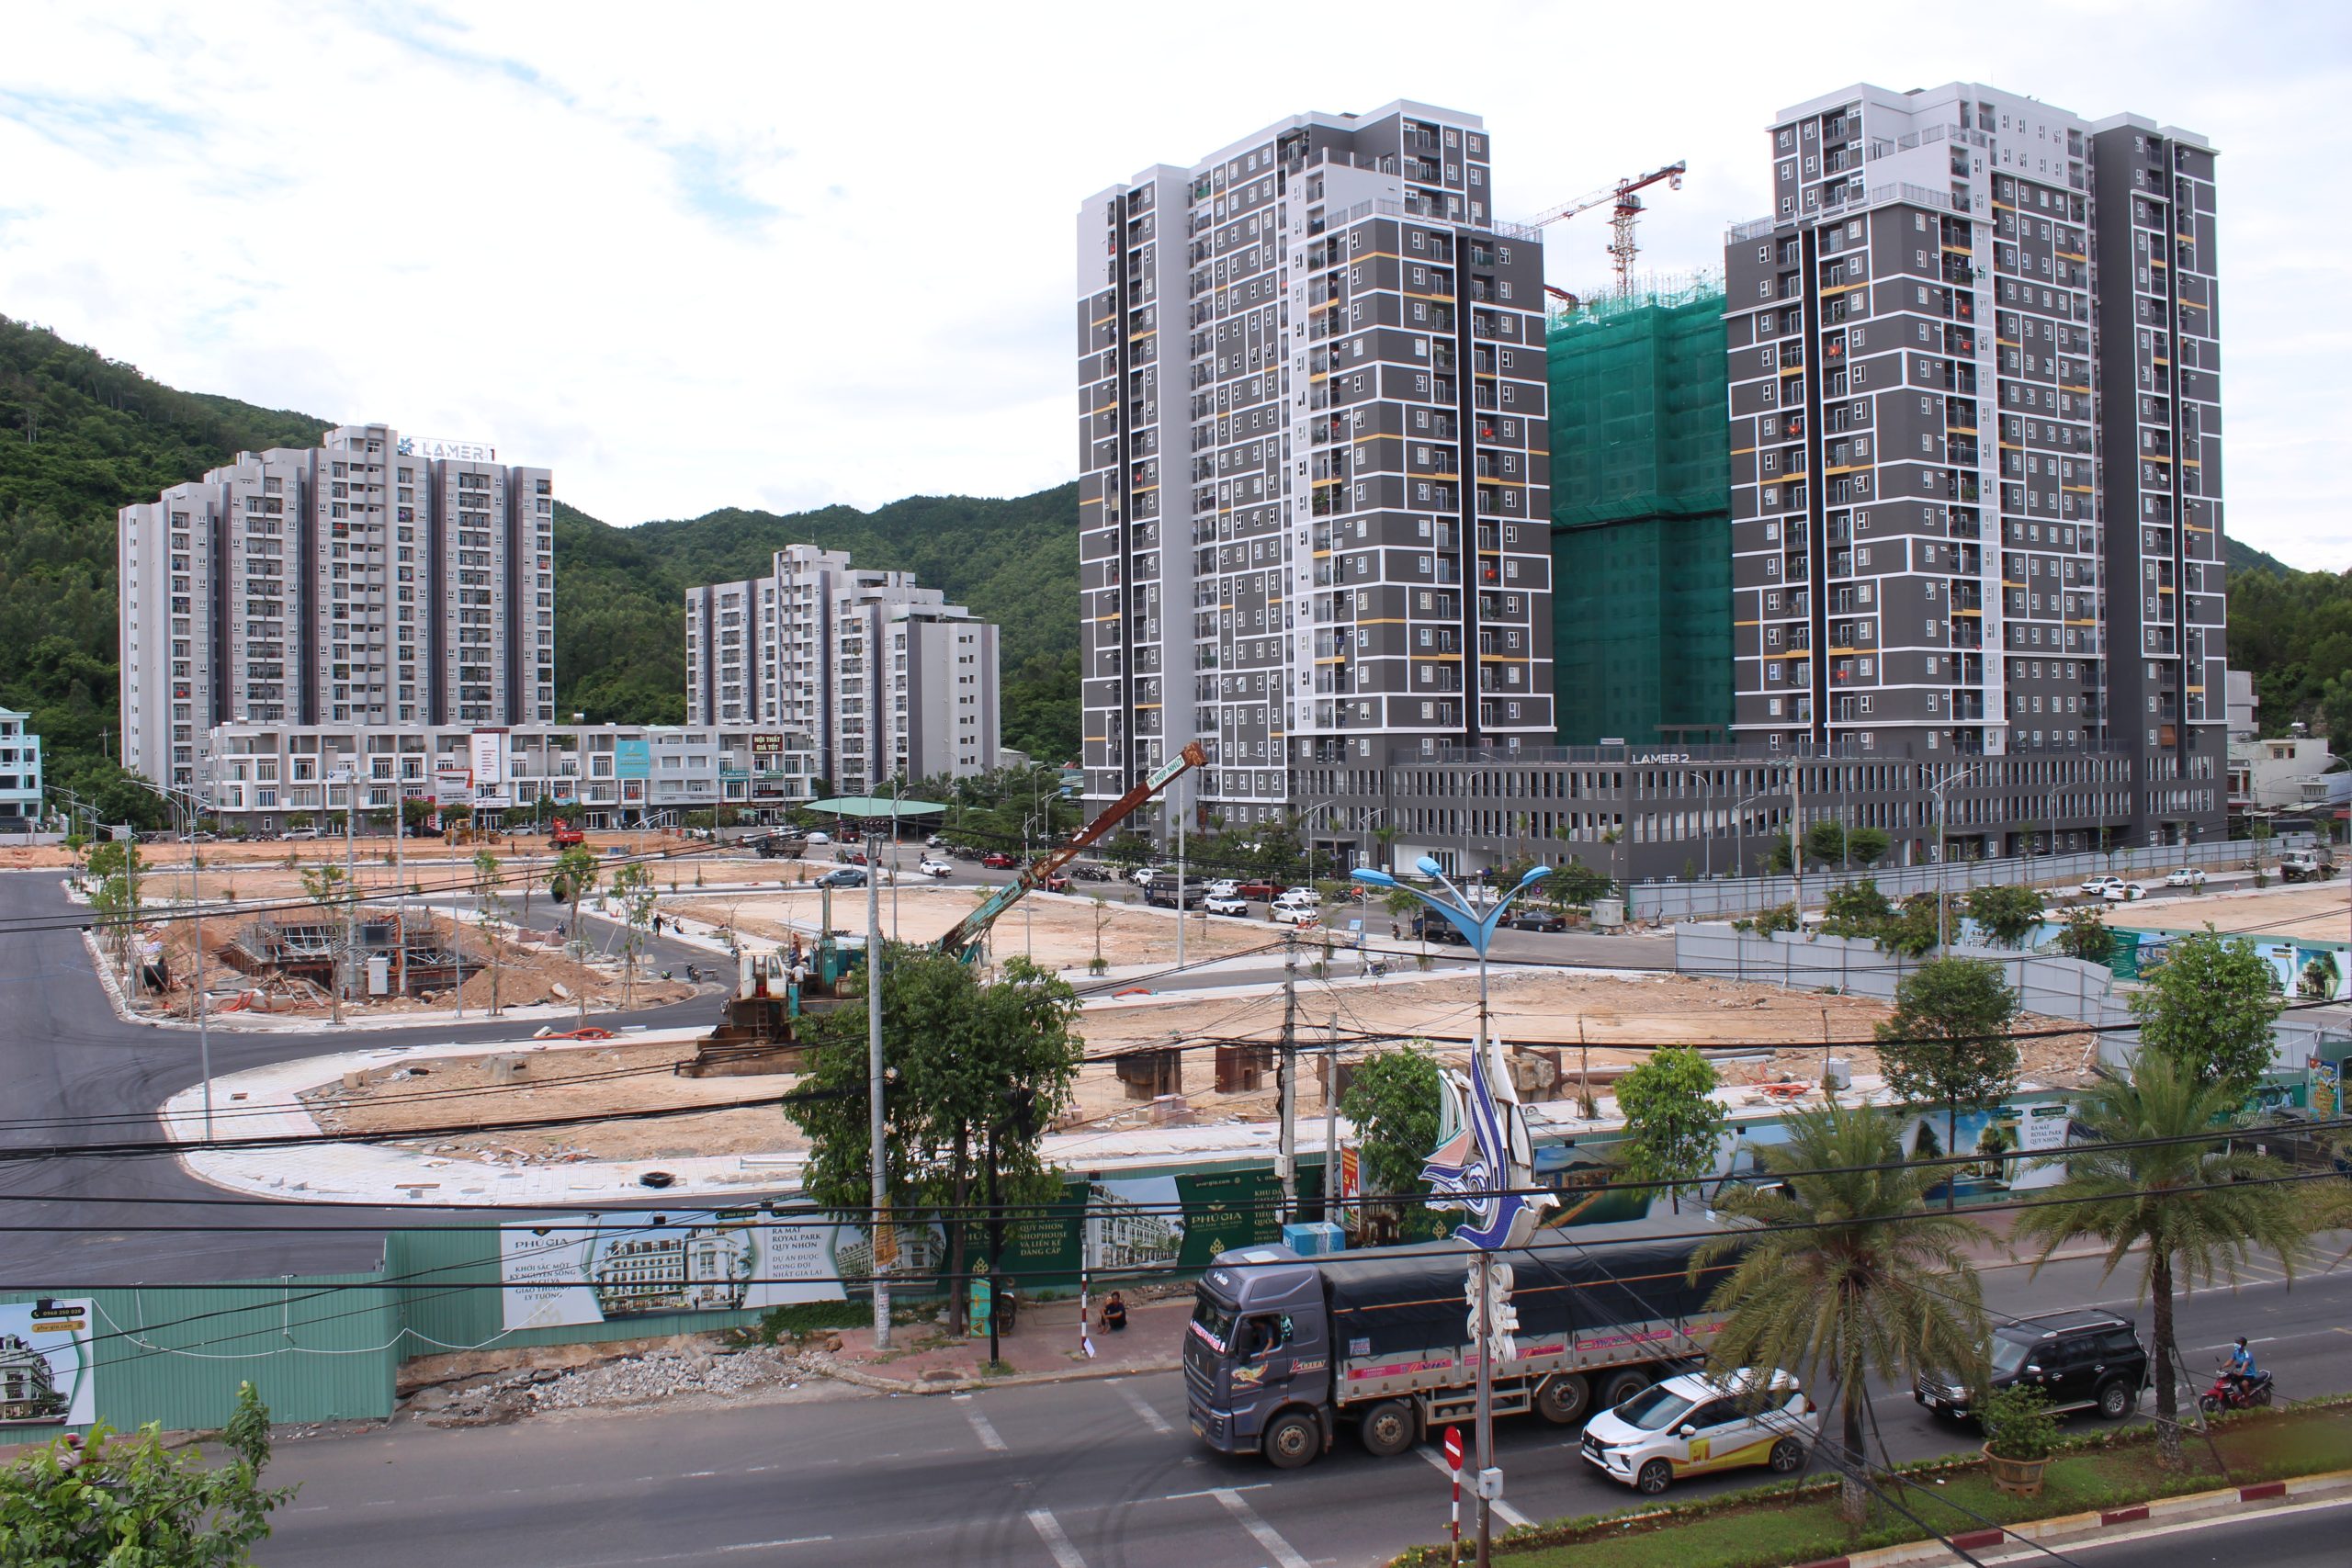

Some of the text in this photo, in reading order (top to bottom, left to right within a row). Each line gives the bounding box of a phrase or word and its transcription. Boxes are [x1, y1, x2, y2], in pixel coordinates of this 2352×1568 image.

[423, 442, 495, 461] LAMER 1
[1632, 753, 1690, 764] LAMER 2
[800, 1233, 821, 1241] PARK
[772, 1243, 790, 1252] QUY
[772, 1263, 796, 1271] MONG
